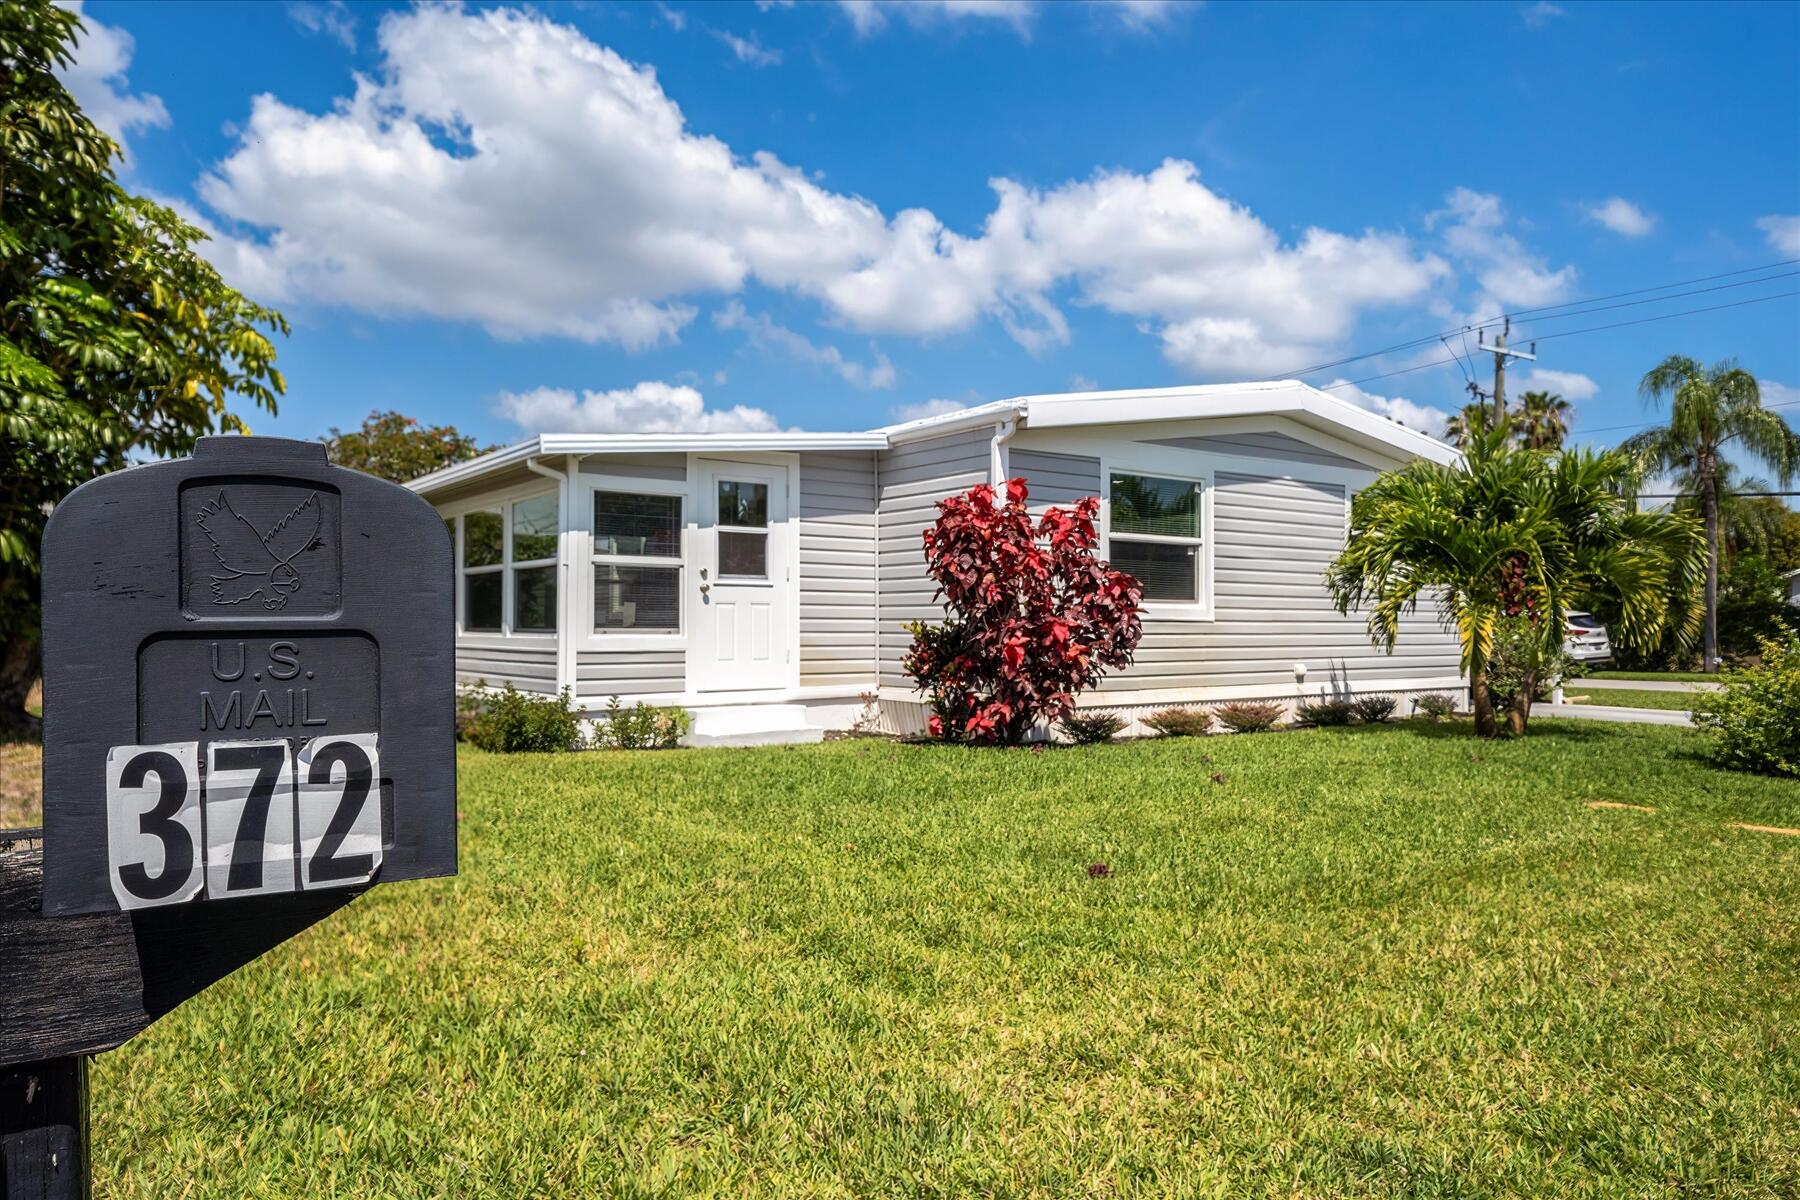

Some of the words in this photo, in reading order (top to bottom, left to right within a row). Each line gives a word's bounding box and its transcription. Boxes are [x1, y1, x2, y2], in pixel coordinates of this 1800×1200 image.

[211, 641, 314, 682] U.S.
[200, 688, 328, 731] MAIL
[118, 740, 375, 900] 372
